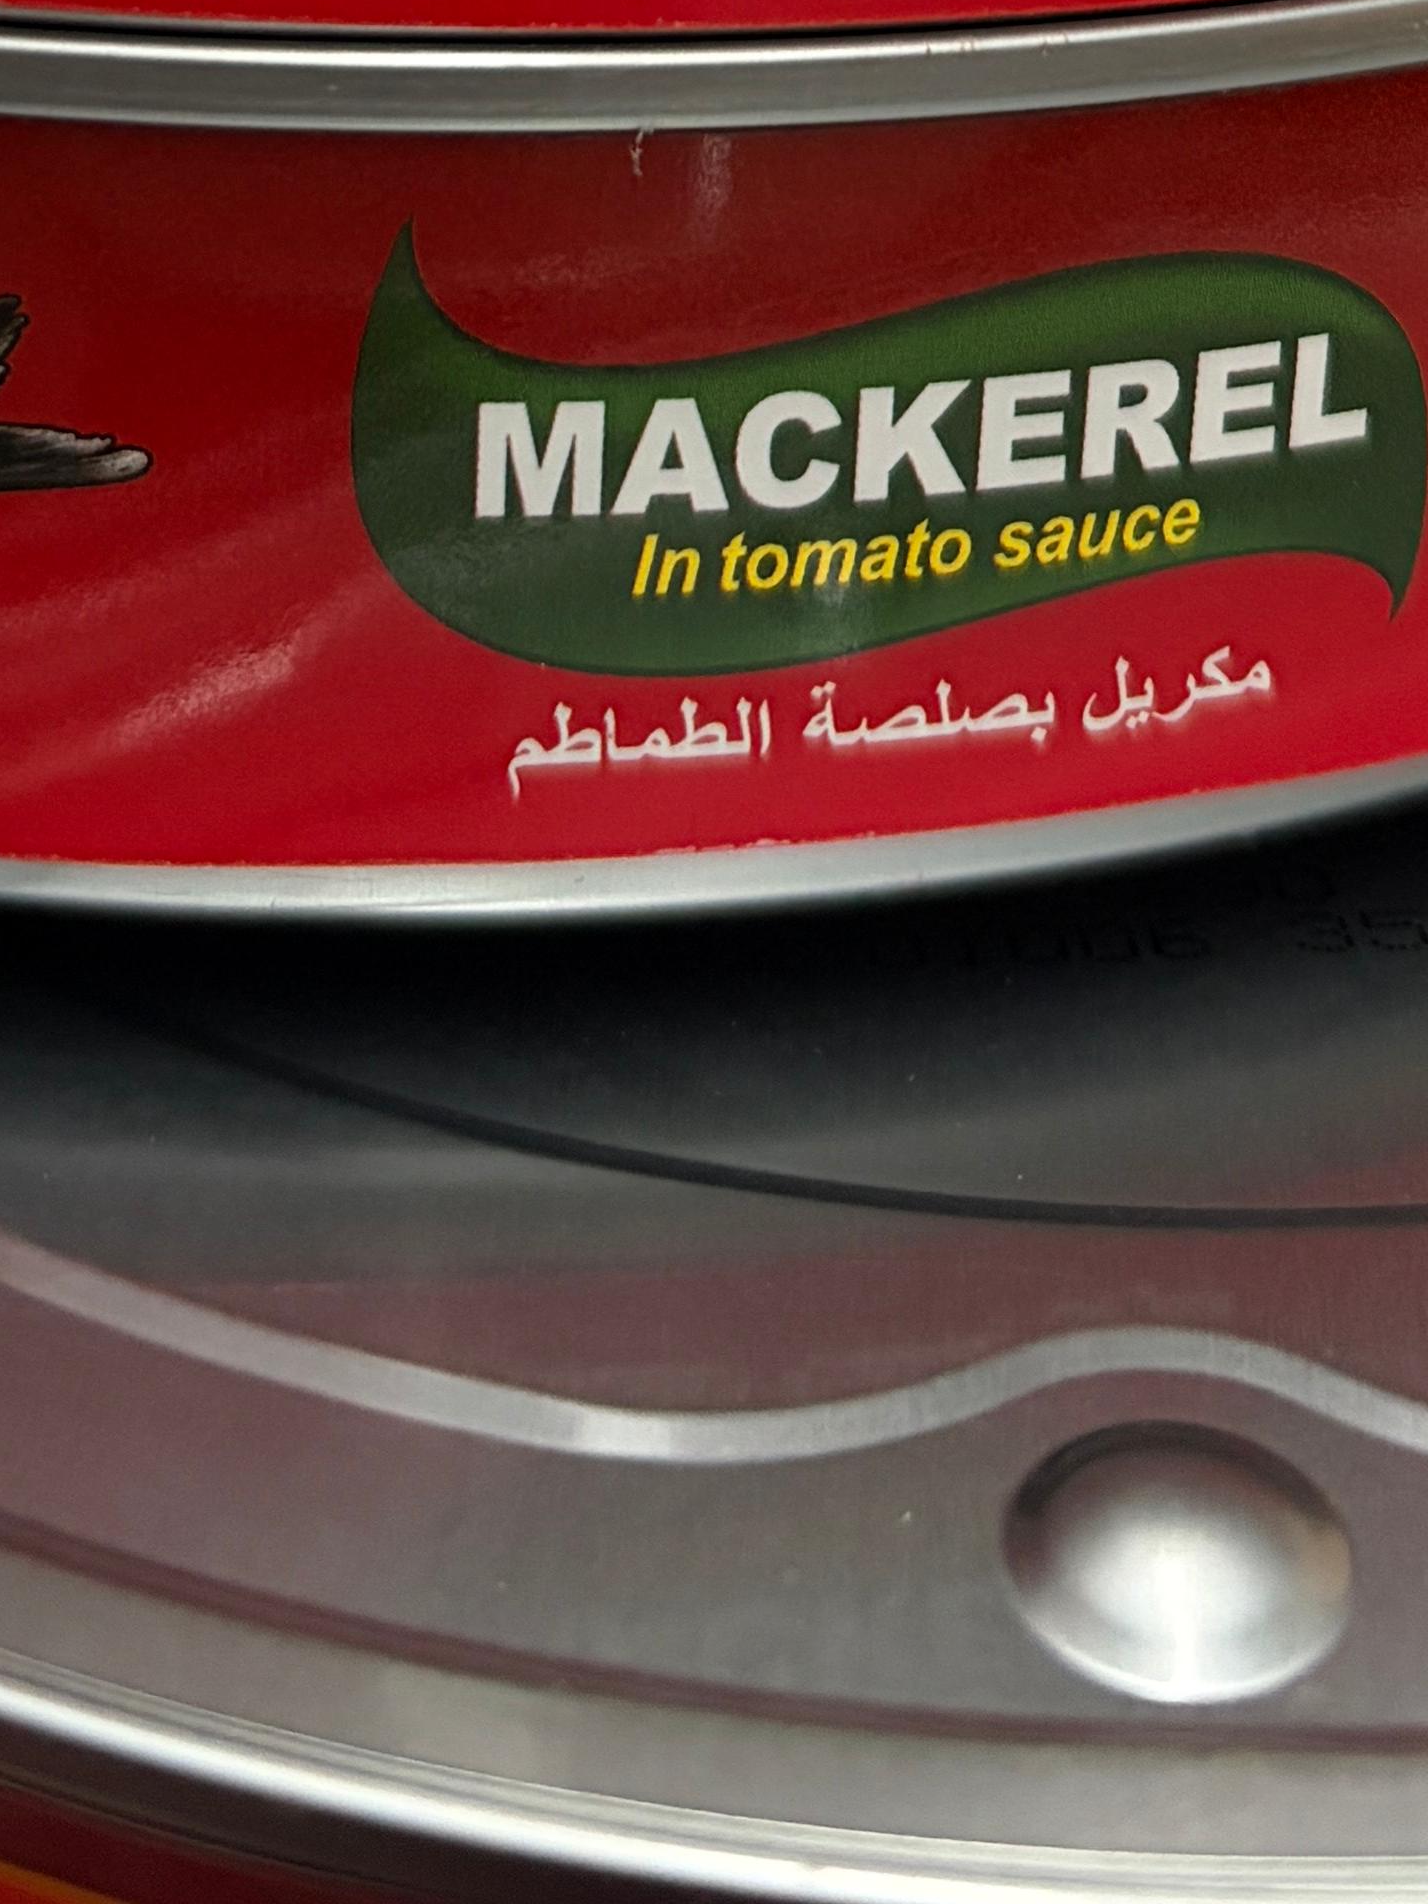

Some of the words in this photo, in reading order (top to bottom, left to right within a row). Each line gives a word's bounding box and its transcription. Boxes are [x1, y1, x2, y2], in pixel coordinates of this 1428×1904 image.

[475, 332, 1368, 520] MACKEREL
[632, 533, 700, 596] In
[720, 513, 972, 592] tomato
[994, 496, 1202, 570] sauce
[802, 679, 1057, 748] بصلصة
[1081, 646, 1272, 730] مكريل
[506, 696, 770, 799] الطماطم
